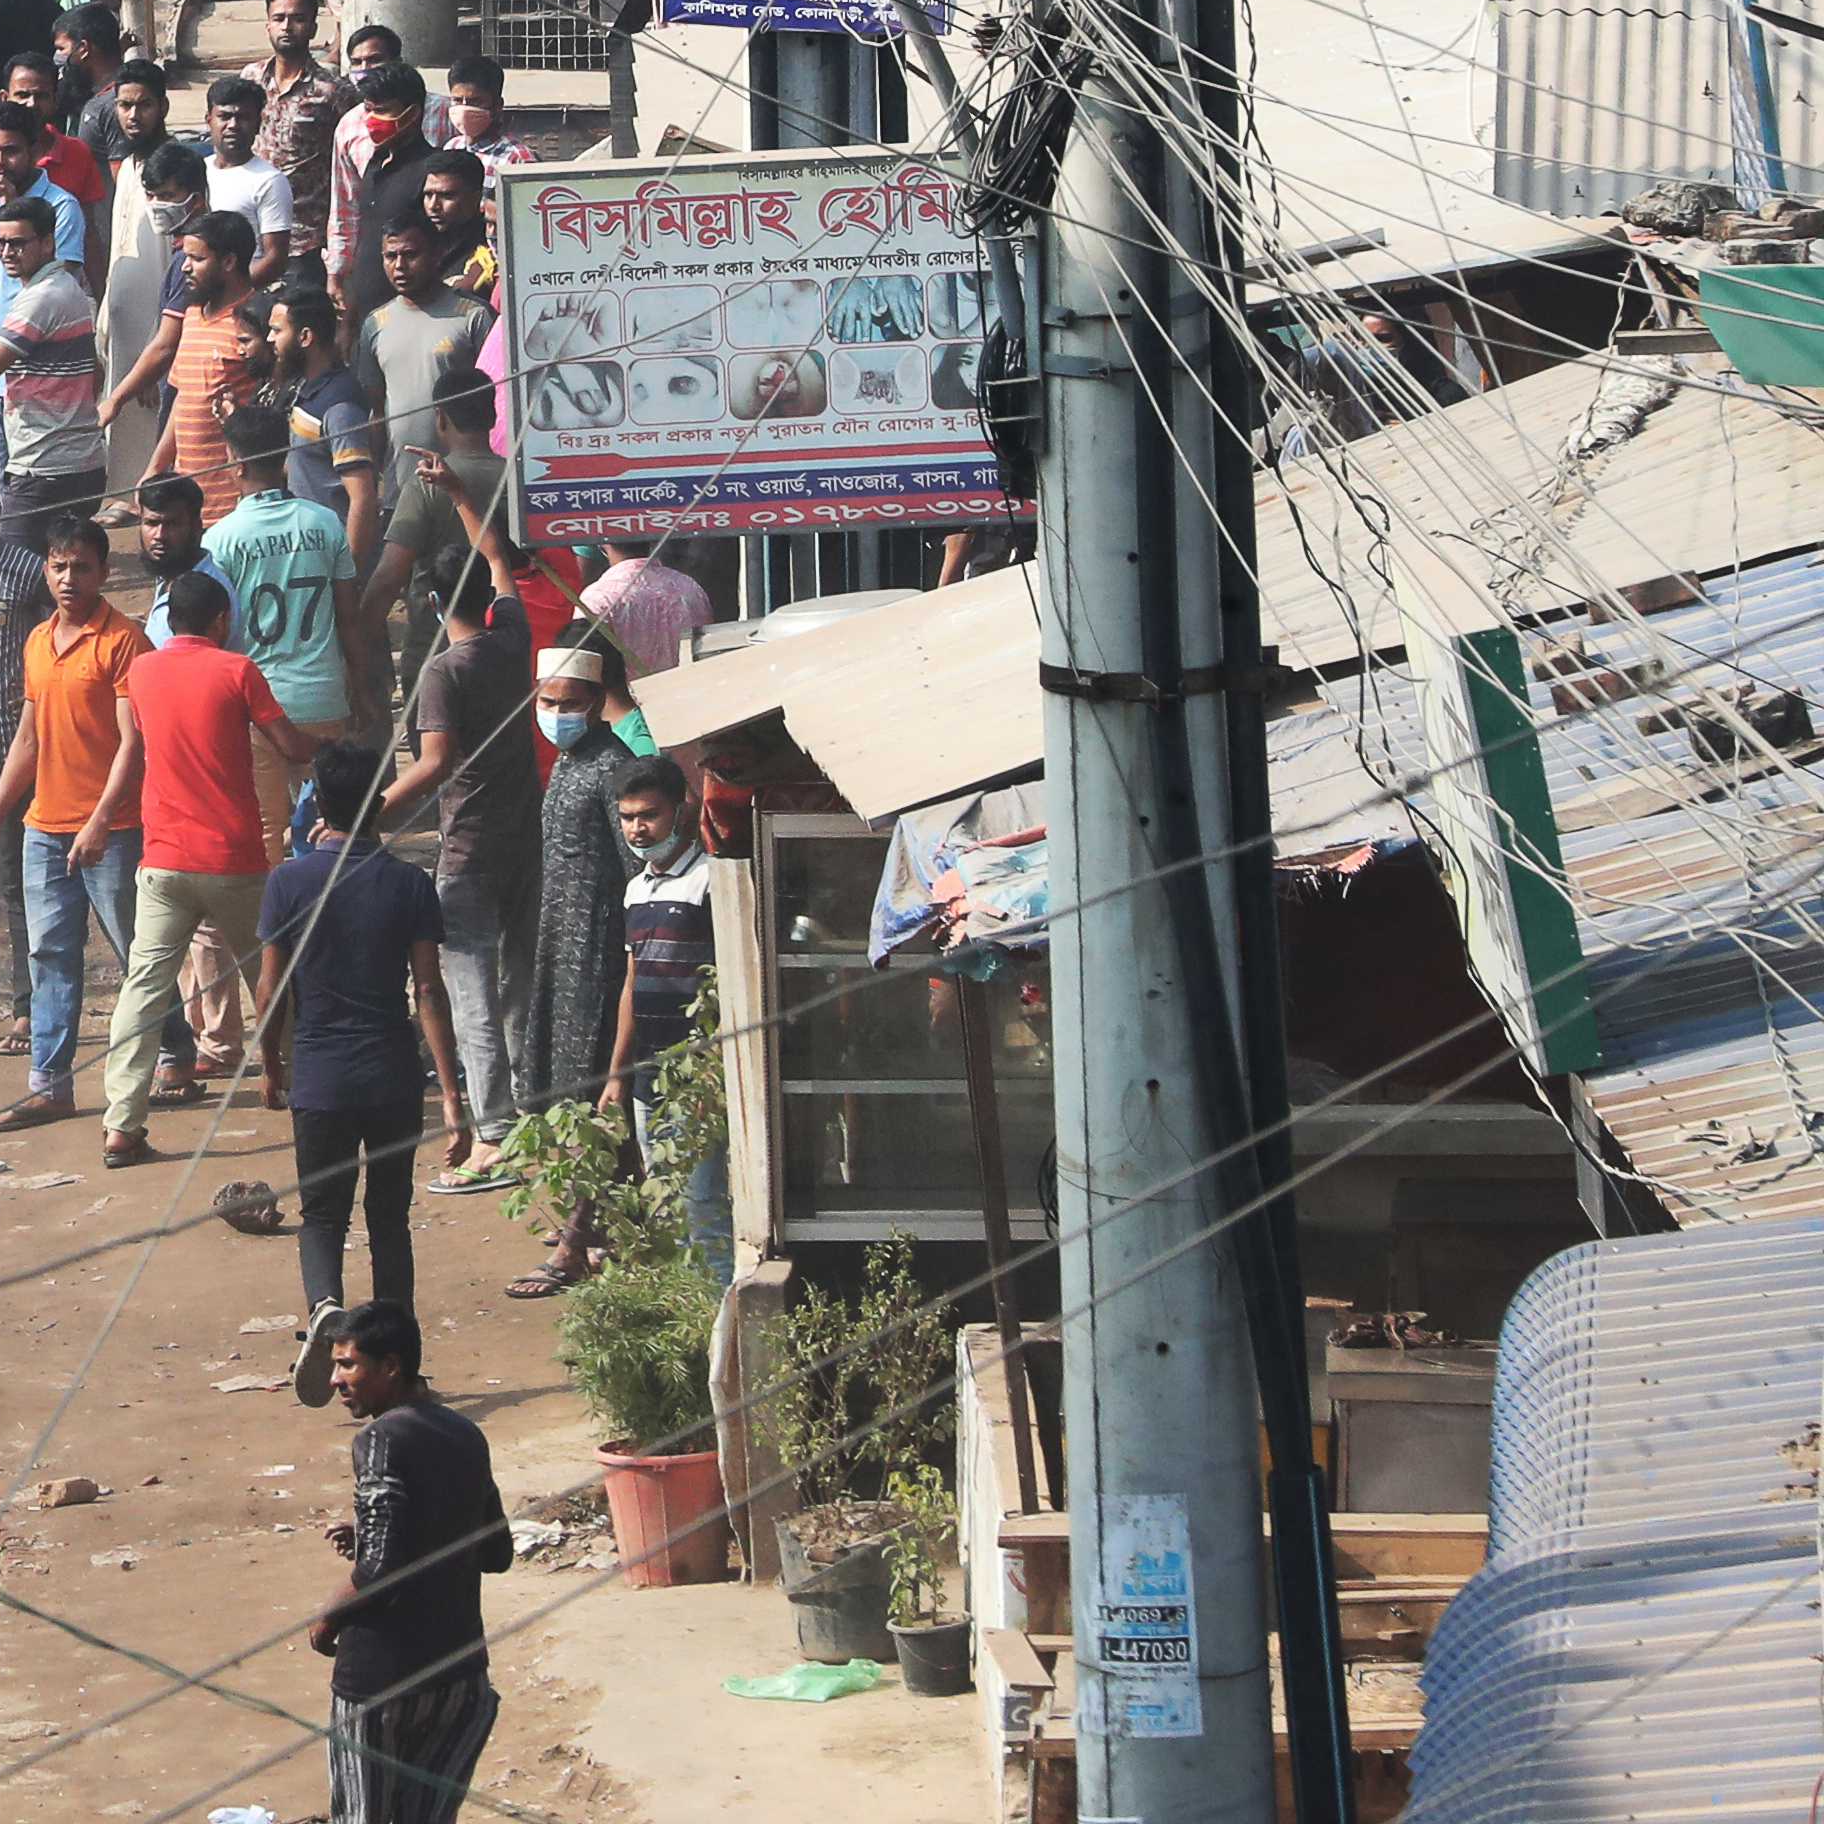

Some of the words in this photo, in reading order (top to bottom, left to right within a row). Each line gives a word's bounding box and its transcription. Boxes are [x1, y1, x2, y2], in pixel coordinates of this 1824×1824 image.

[681, 2, 747, 20] কাশিমপুর
[529, 269, 575, 288] এখানে
[580, 259, 668, 287] দেশী-বিদেশী
[673, 262, 709, 278] সকল
[713, 260, 753, 277] প্রকার
[814, 252, 864, 273] মাধ্যমে
[867, 249, 920, 269] যাবতীয়
[926, 249, 974, 267] রোগের
[556, 432, 583, 450] বিঃ
[587, 433, 611, 449] দ্রঃ
[617, 429, 659, 445] সকল
[665, 427, 713, 443] প্রকার
[719, 424, 759, 442] নতুন
[766, 421, 825, 441] পুরাতন
[832, 415, 870, 435] যৌন
[878, 415, 935, 433] রোগের
[528, 491, 560, 510] হক
[564, 487, 614, 510] সুপার
[619, 479, 685, 503] মার্কেট,
[724, 480, 751, 498] নং
[755, 473, 814, 497] ওয়ার্ড,
[818, 473, 905, 493] নাওজোর,
[911, 470, 966, 489] বাসন,
[267, 528, 326, 557] PALASH
[249, 576, 329, 647] 07
